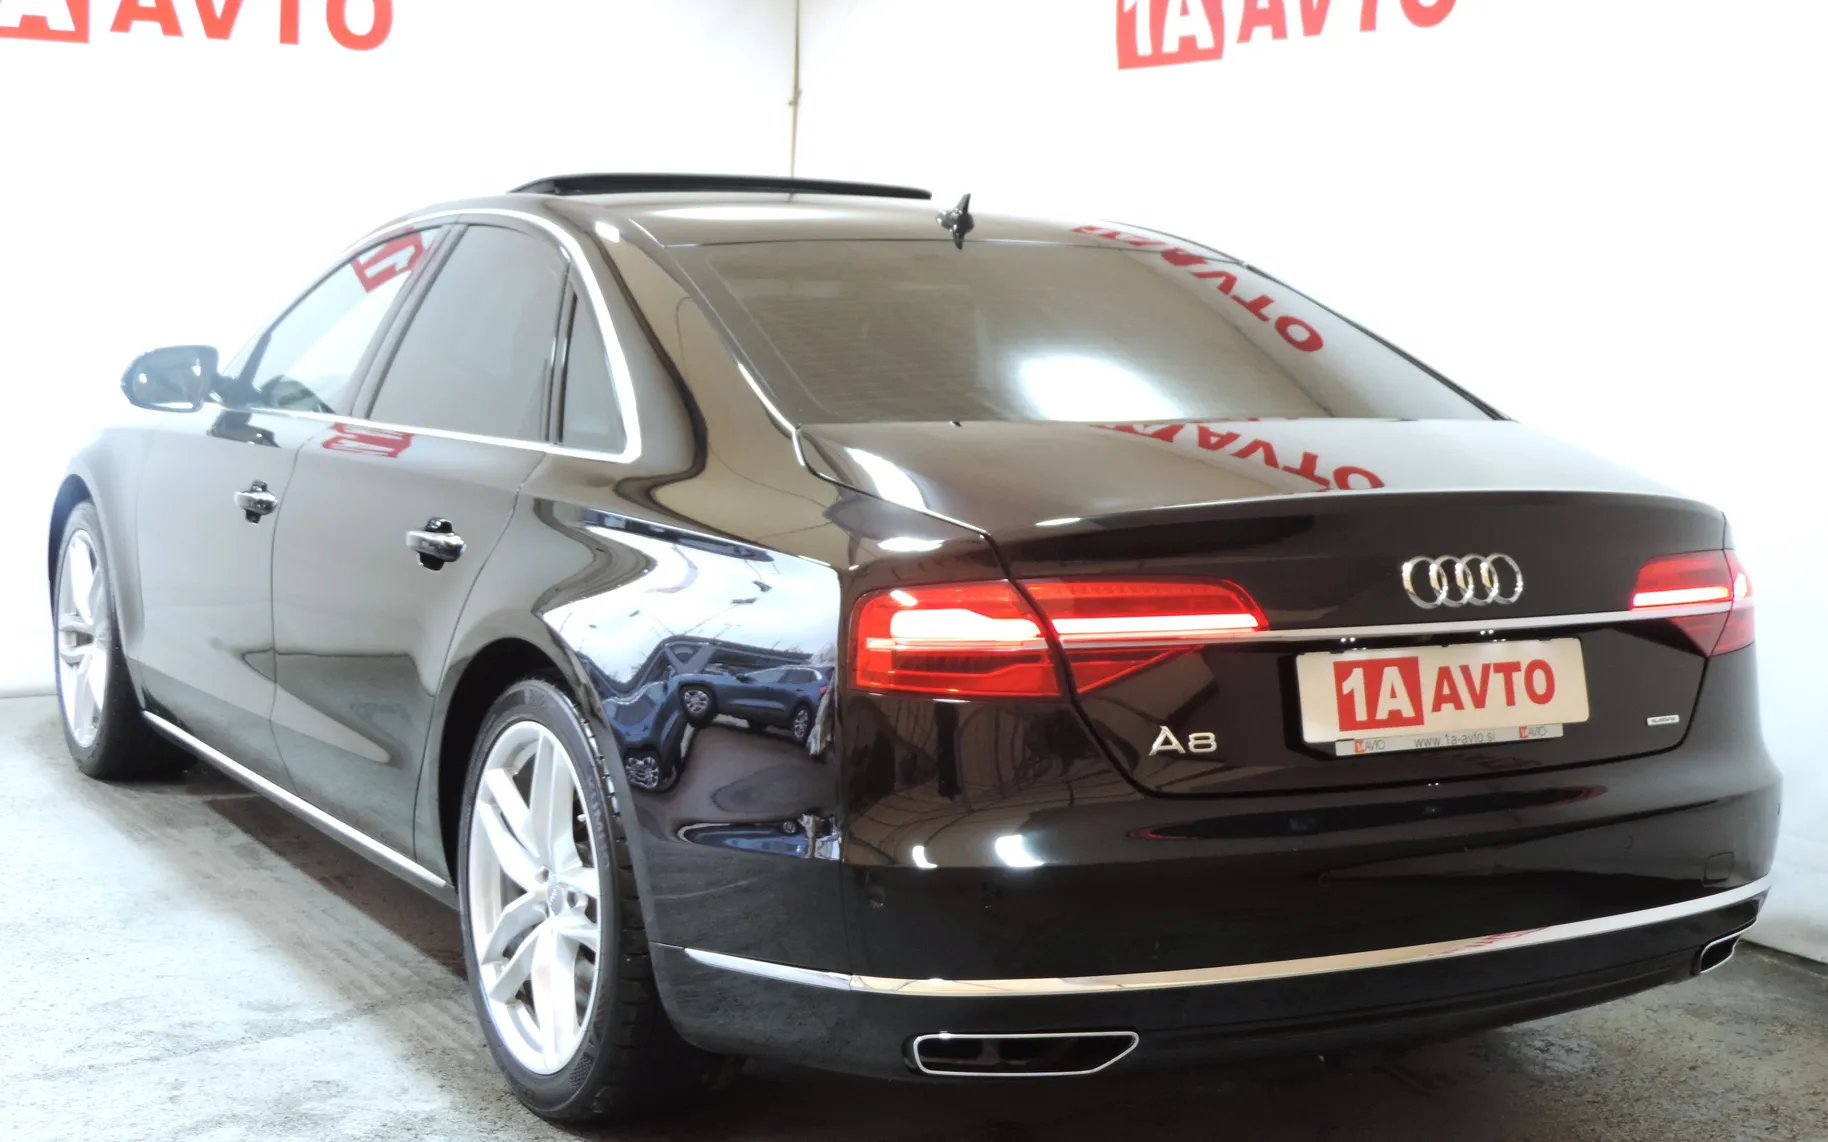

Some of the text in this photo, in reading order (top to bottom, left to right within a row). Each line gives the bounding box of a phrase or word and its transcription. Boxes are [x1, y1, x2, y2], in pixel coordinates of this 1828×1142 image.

[1341, 658, 1556, 722] 1A AVTO
[1148, 725, 1218, 756] A8
[1413, 731, 1496, 748] www.1a-avto.si
